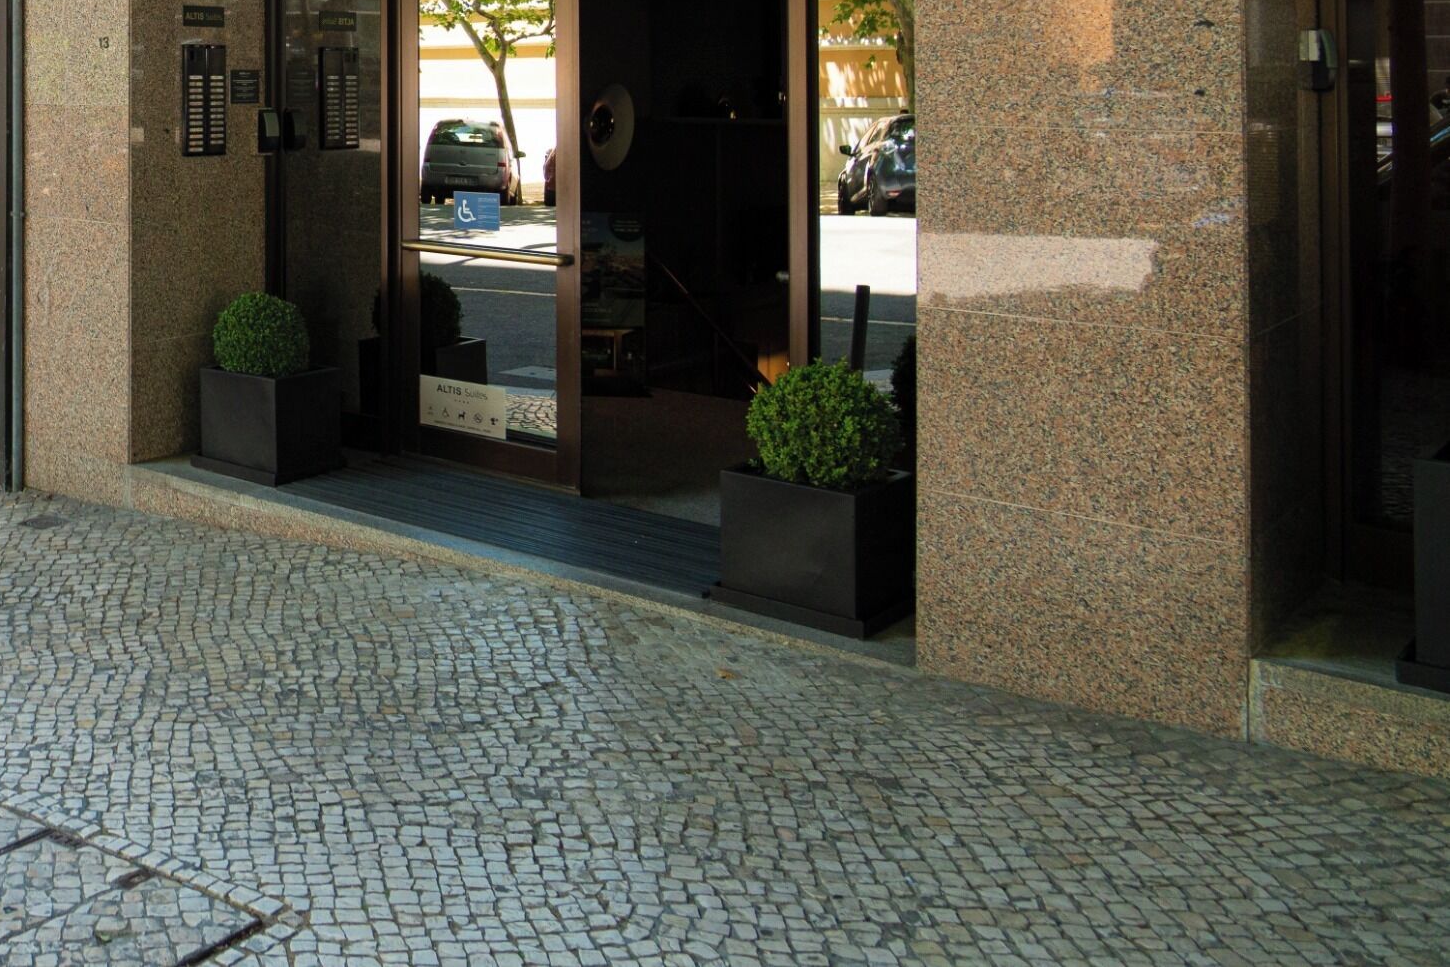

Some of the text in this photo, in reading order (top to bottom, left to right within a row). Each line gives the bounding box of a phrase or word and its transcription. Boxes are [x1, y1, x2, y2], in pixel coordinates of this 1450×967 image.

[184, 12, 205, 21] ALTIS
[99, 36, 110, 50] 13
[436, 384, 488, 400] ALTIS Suites
